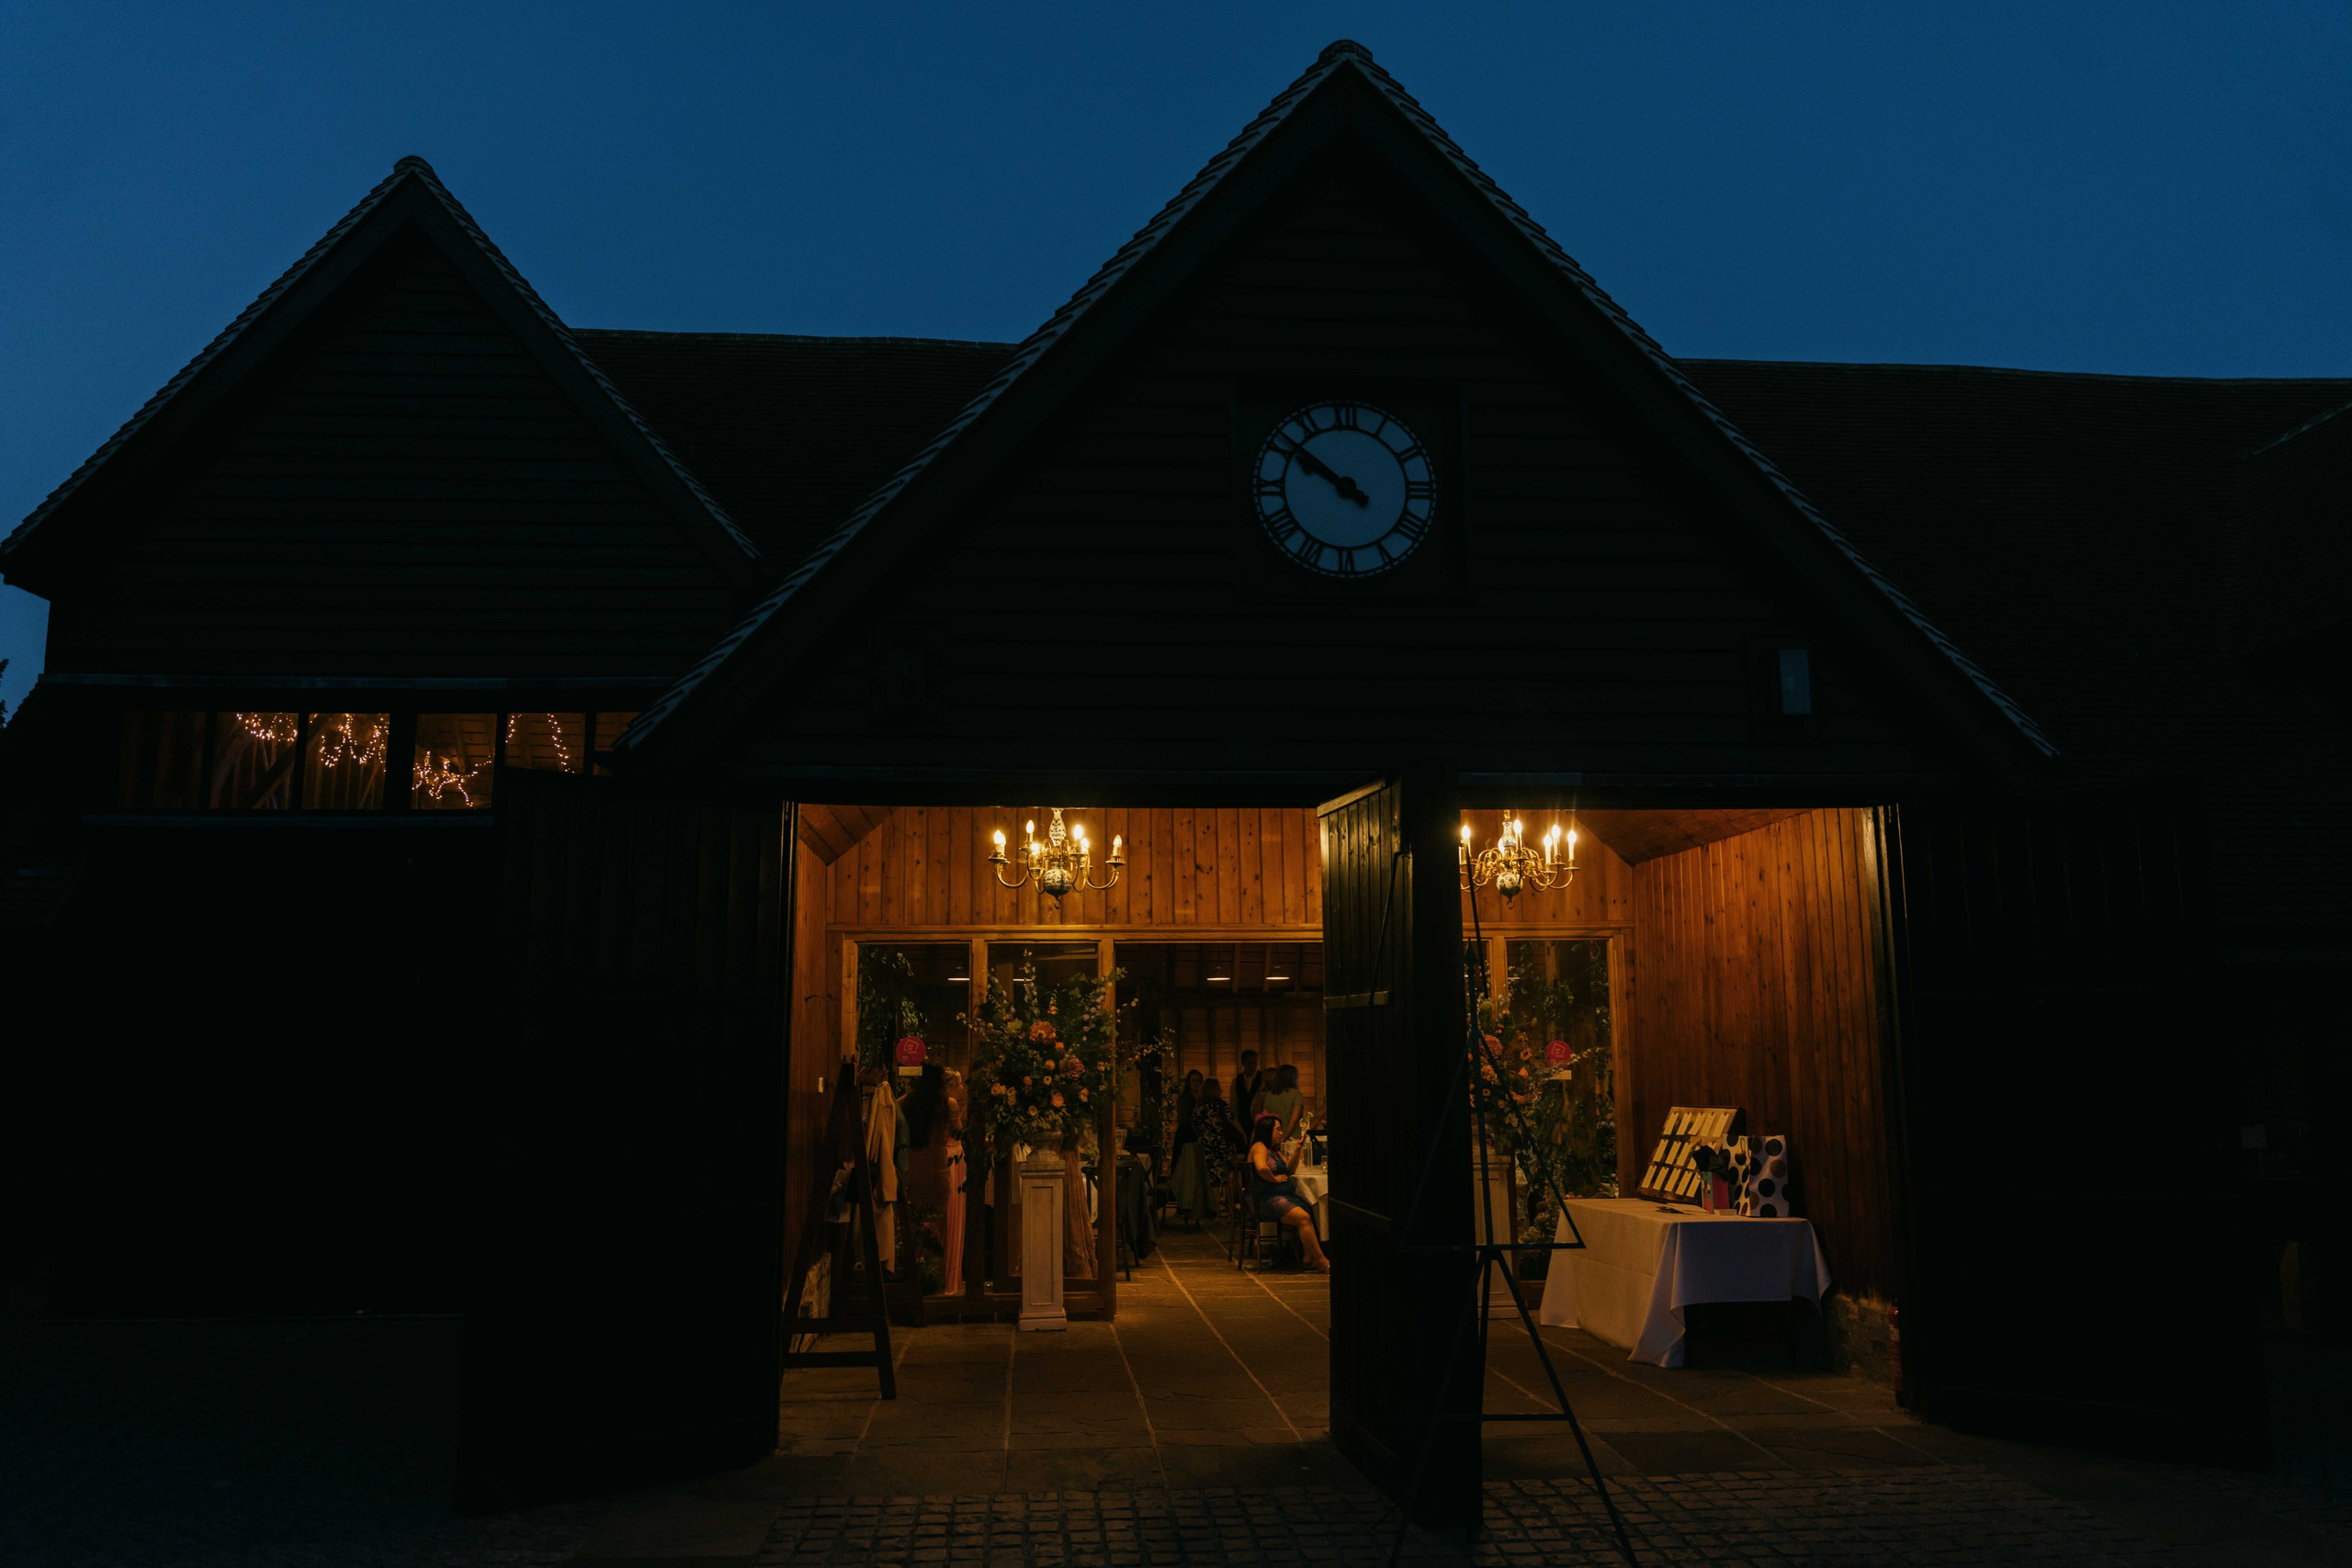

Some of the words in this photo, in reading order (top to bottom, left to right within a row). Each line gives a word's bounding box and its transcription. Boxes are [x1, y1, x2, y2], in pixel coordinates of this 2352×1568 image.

[1334, 405, 1356, 428] XII
[1374, 415, 1387, 437] I
[1396, 443, 1423, 462] II
[1260, 478, 1284, 496] IX
[1406, 480, 1430, 499] III
[1267, 507, 1300, 540] VIII
[1396, 507, 1428, 542] IIII
[1297, 536, 1323, 564] VII
[1338, 548, 1355, 572] VI
[1374, 540, 1393, 565] V
